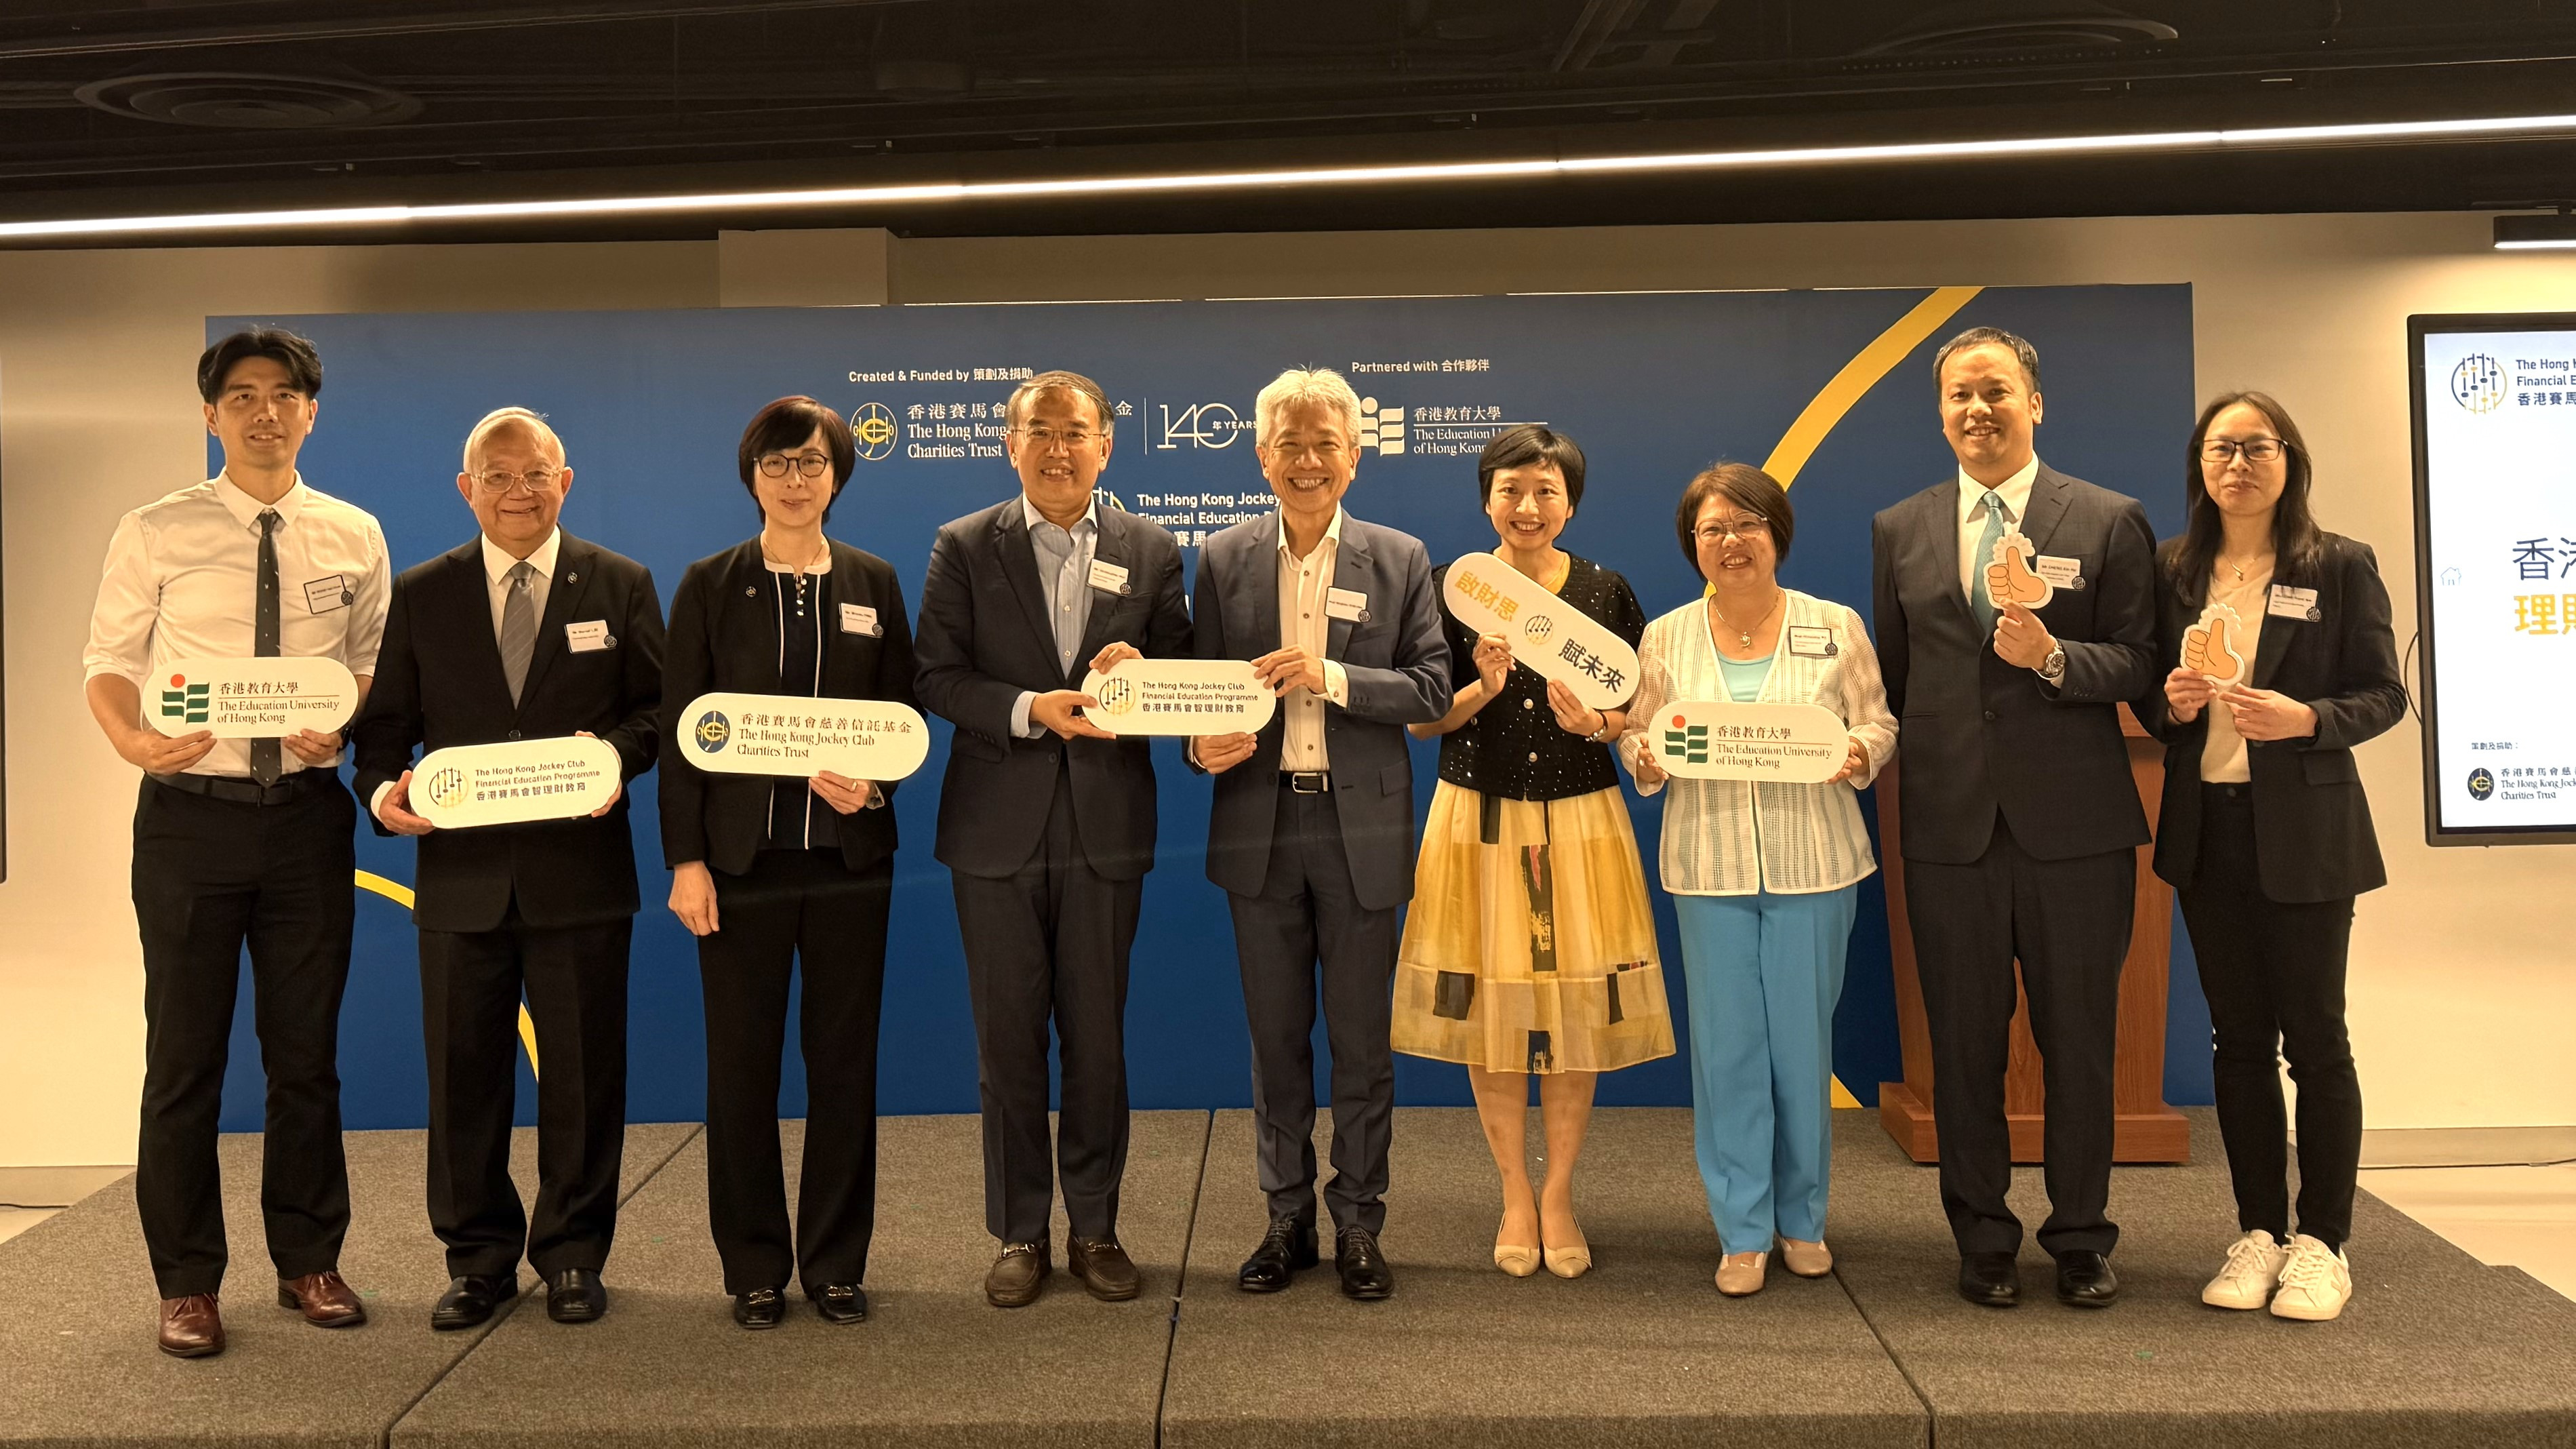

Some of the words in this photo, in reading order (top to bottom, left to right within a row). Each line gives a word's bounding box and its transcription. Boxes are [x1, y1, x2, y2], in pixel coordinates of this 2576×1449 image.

[1352, 361, 1410, 372] Partnered
[1413, 361, 1438, 372] with
[1442, 359, 1489, 372] 合作夥伴
[2516, 359, 2536, 370] The
[2540, 359, 2569, 371] Hong
[849, 371, 894, 382] Created
[898, 371, 906, 381] &
[910, 370, 952, 381] Funded
[956, 370, 969, 382] by
[973, 367, 1033, 380] 策劃及捐助
[2517, 375, 2567, 386] Financial
[2518, 392, 2576, 405] 香港賽馬
[1413, 405, 1501, 422] 香港教育大學
[908, 424, 933, 438] The
[936, 424, 971, 441] Hong
[975, 423, 1007, 441] Kong
[1156, 403, 1239, 449] 140
[1413, 428, 1434, 439] The
[1437, 428, 1490, 439] Education
[908, 443, 965, 458] Charities
[968, 443, 1003, 457] Trust
[1413, 442, 1426, 454] of
[1428, 442, 1457, 456] Hong
[1137, 494, 1161, 507] The
[1165, 493, 1198, 508] Hong
[1202, 492, 1234, 507] Kong
[1238, 492, 1281, 507] Jockey
[1199, 511, 1260, 524] Education
[1558, 637, 1626, 693] 賦未來
[219, 681, 298, 695] 香港教育大學
[1158, 682, 1177, 690] Hong
[1180, 682, 1199, 690] Kong
[1200, 682, 1226, 691] Jockey
[1215, 693, 1258, 701] Programme
[218, 701, 237, 711] The
[239, 700, 287, 711] Education
[289, 699, 340, 711] University
[217, 713, 228, 723] of
[230, 713, 257, 725] Hong
[260, 713, 285, 724] Kong
[739, 728, 757, 740] The
[761, 730, 786, 744] Hong
[790, 731, 814, 745] Kong
[815, 732, 849, 748] Jockey
[853, 734, 874, 746] Club
[1717, 726, 1791, 739] 香港教育大學
[738, 744, 781, 757] Charities
[784, 747, 809, 758] Trust
[1716, 744, 1733, 753] The
[1736, 745, 1782, 755] Education
[1784, 746, 1832, 759] University
[492, 768, 512, 776] Hong
[538, 763, 565, 771] Jockey
[567, 760, 585, 768] Club
[1716, 756, 1727, 765] of
[1729, 756, 1753, 768] Hong
[1755, 757, 1780, 769] Kong
[2500, 766, 2576, 777] 香港賽馬會慈
[475, 778, 511, 788] Financial
[514, 775, 552, 784] Education
[554, 770, 600, 780] Programme
[2501, 780, 2515, 788] The
[2558, 778, 2576, 789] Jock
